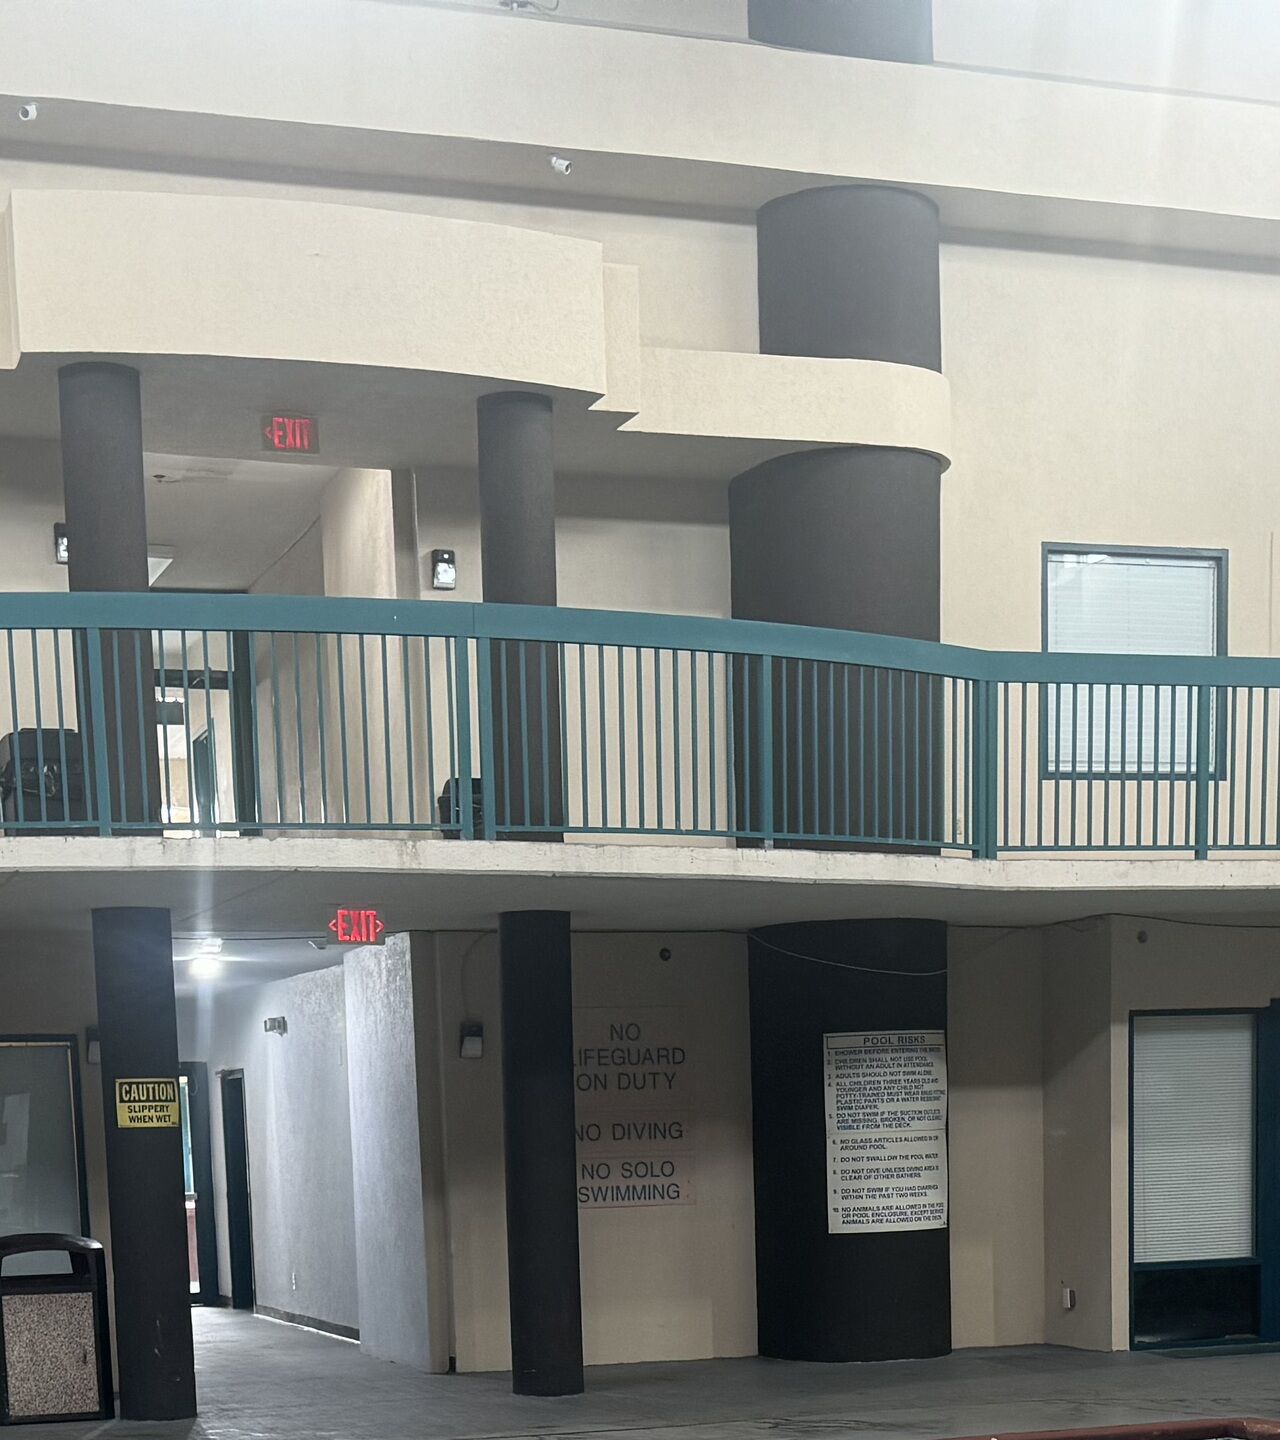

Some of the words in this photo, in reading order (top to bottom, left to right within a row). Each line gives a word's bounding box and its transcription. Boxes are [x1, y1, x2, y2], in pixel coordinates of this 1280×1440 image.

[272, 416, 312, 449] EXIT
[337, 909, 377, 942] EXIT
[609, 1023, 641, 1041] NO
[863, 1036, 895, 1045] POOL
[897, 1035, 926, 1044] RISKS
[576, 1074, 608, 1092] ON
[617, 1072, 677, 1091] DUTY
[122, 1083, 174, 1101] CAUTION
[127, 1104, 170, 1114] SLIPPERY
[128, 1114, 154, 1123] WHEN
[155, 1114, 171, 1123] WET
[612, 1122, 684, 1141] DIVING
[581, 1163, 611, 1180] NO
[621, 1160, 675, 1179] SOLO
[578, 1183, 681, 1203] SWIMMING
